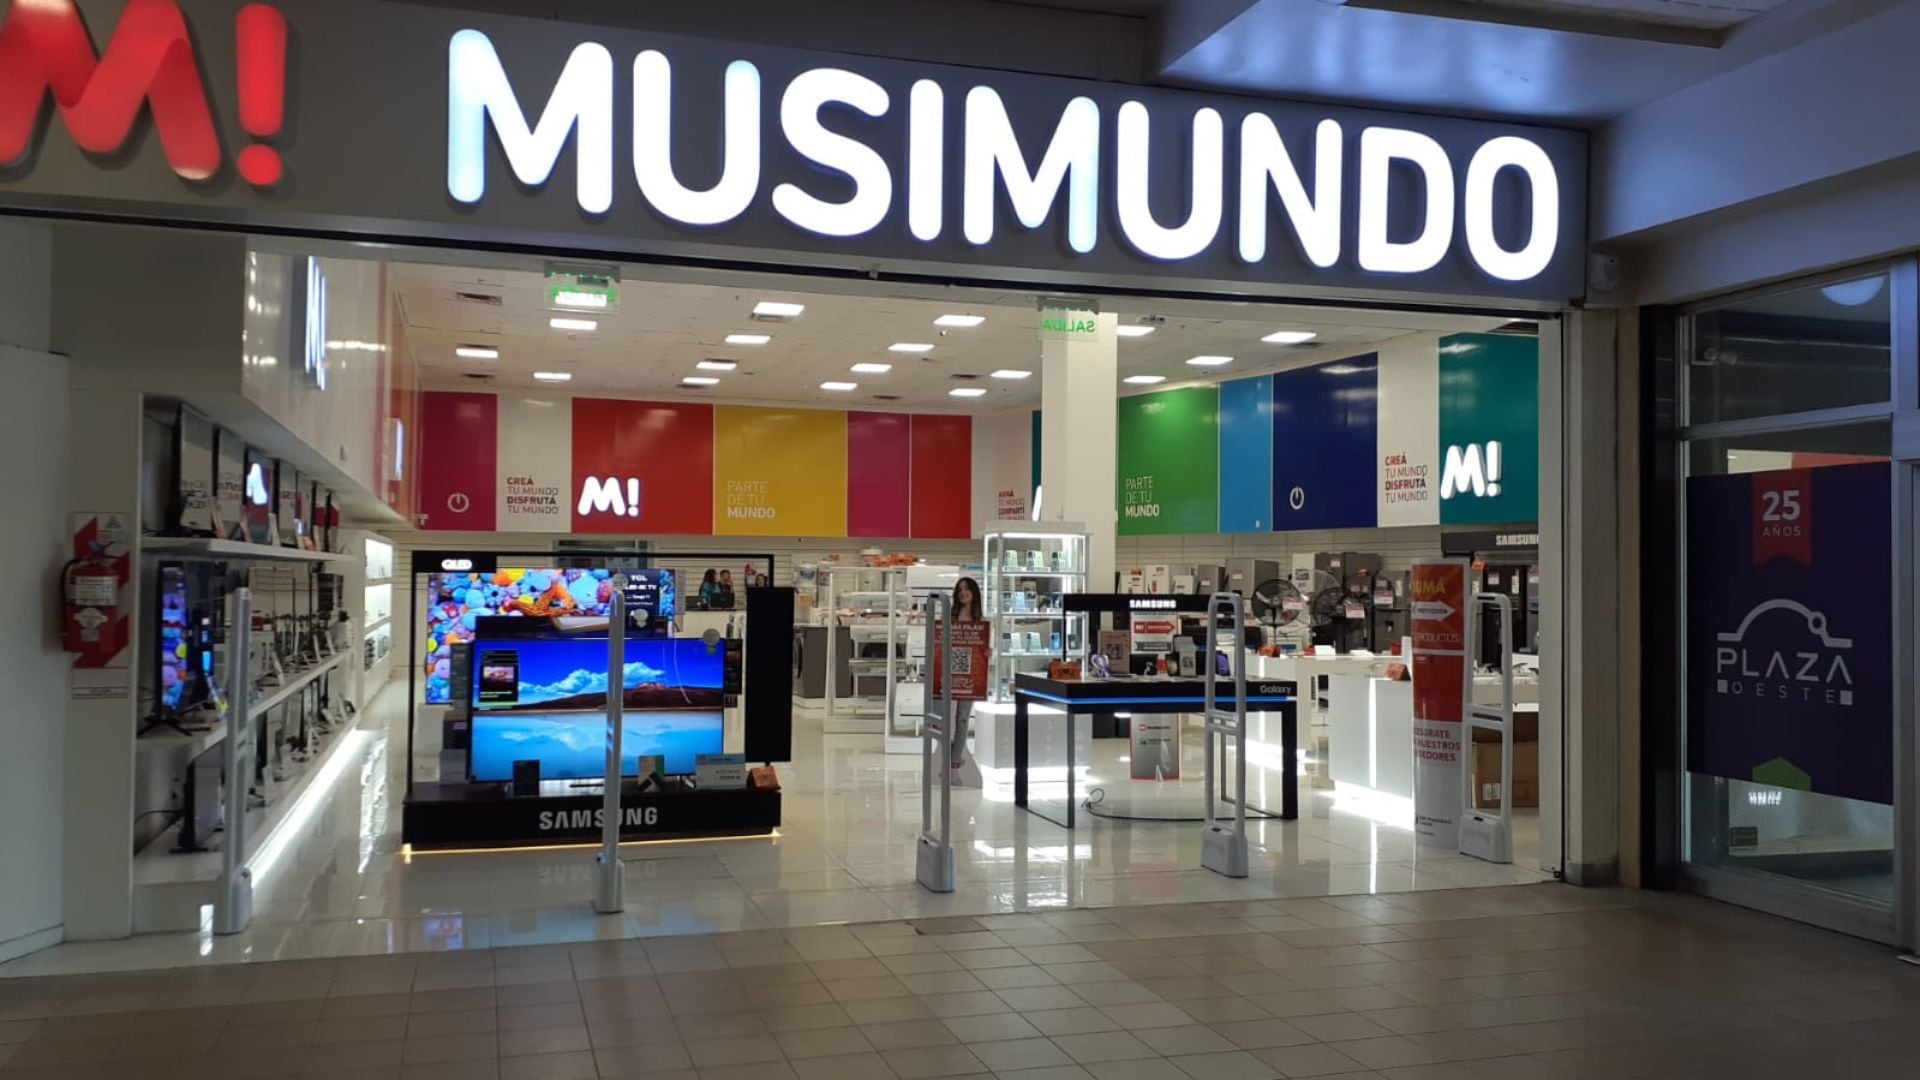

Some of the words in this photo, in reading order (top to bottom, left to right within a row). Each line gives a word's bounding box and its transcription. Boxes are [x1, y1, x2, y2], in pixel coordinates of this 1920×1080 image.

[448, 29, 1559, 280] MUSIMUNDO
[1385, 451, 1407, 466] CREÁ
[1385, 467, 1396, 479] TU
[1398, 464, 1428, 477] MUNDO
[727, 480, 769, 493] PARTE
[1125, 475, 1154, 490] PARTE
[508, 487, 520, 495] TU
[522, 487, 559, 496] MUNDO
[577, 475, 640, 517] M!
[1125, 491, 1138, 505] DE
[1140, 490, 1153, 504] TU
[1385, 492, 1396, 504] TU
[1398, 490, 1428, 502] MUNDO
[728, 493, 745, 506] DE
[748, 493, 766, 506] TU
[1762, 489, 1801, 521] 25
[508, 505, 520, 514] TU
[522, 505, 559, 515] MUNDO
[727, 506, 776, 519] MUNDO
[1125, 504, 1160, 518] MUNDO
[1762, 523, 1801, 537] AÑOS
[1495, 534, 1539, 546] SAMSUN
[1411, 576, 1446, 595] UMÁ
[1129, 599, 1177, 609] SAMSUNG
[1716, 646, 1853, 685] PLAZA
[1260, 685, 1291, 694] Galaxy
[1731, 680, 1836, 704] OESTE
[539, 806, 657, 830] SAMSNG
